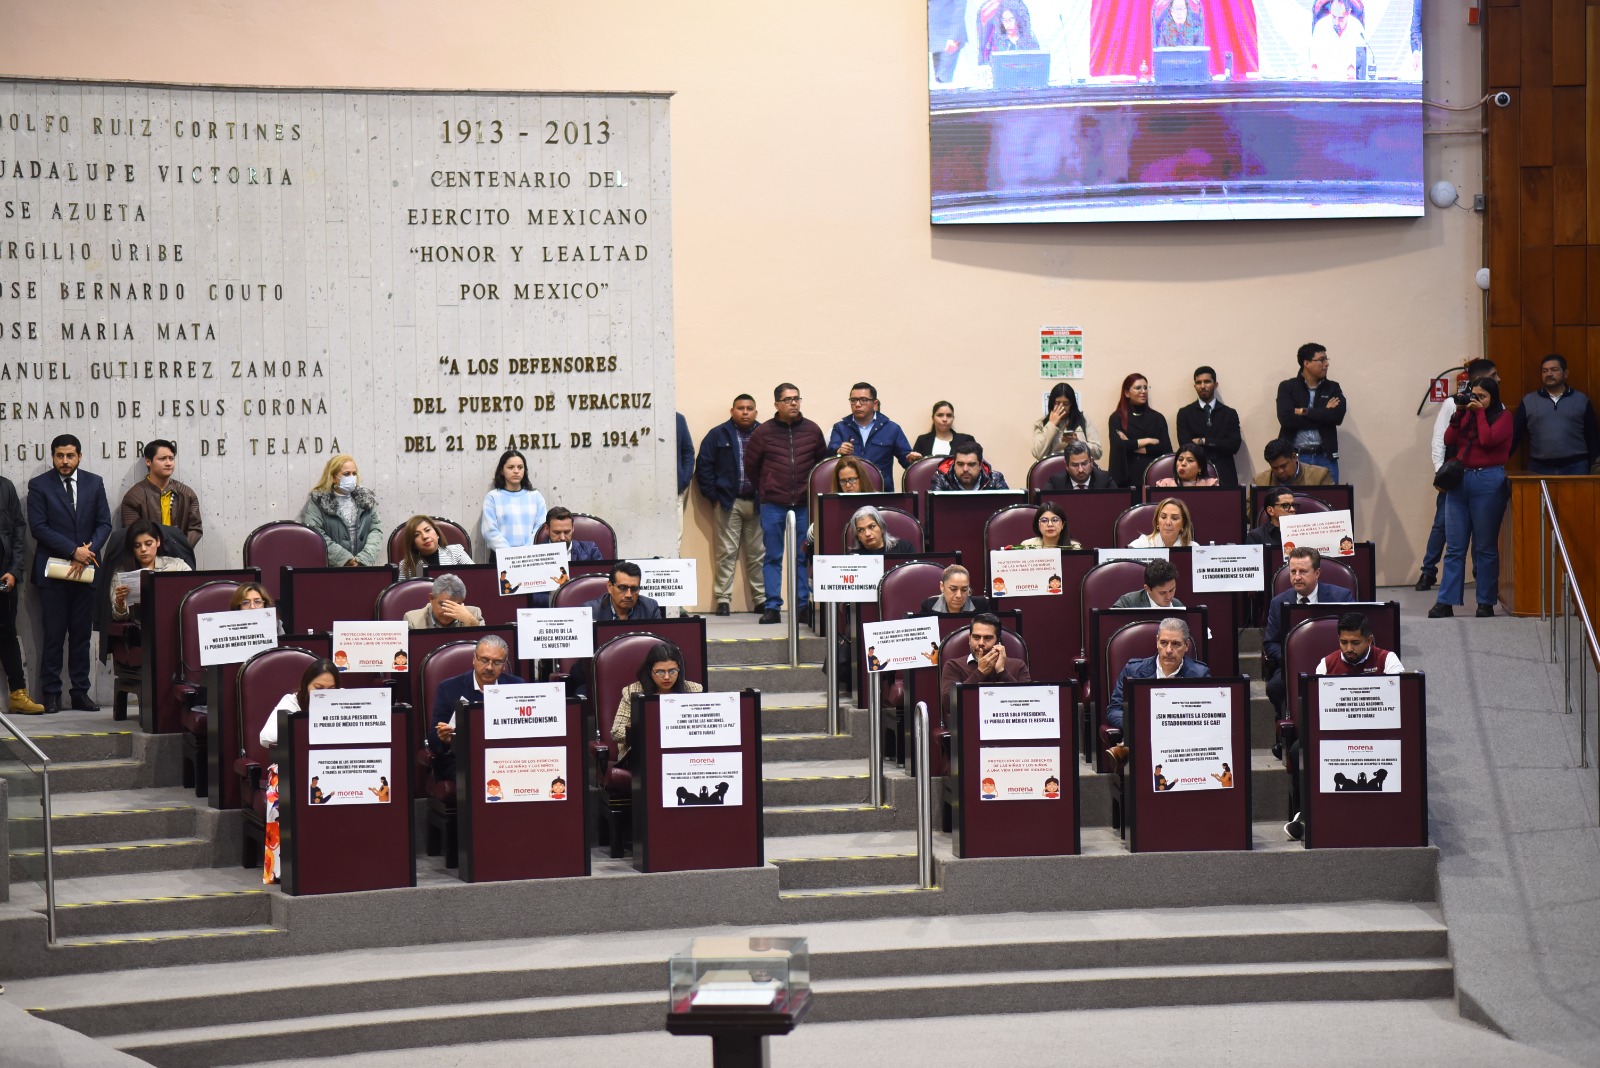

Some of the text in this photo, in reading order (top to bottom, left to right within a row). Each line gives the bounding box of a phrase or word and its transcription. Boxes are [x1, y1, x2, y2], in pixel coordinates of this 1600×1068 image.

[0, 113, 302, 141] OLFO RUIZ CORTINES
[442, 120, 504, 144] 1913
[545, 120, 611, 145] 2013
[159, 165, 292, 186] VICTORIA
[430, 170, 628, 188] CENTENARIO DEL
[51, 202, 147, 222] AZUETA
[407, 208, 648, 226] EJERCITO MEXICANO
[0, 242, 91, 261] RGILIO
[409, 244, 649, 263] “HONOR Y LEALTAD
[0, 282, 284, 302] SE BERNARDO COUTO
[460, 282, 610, 300] POR MEXICO”
[61, 322, 136, 340] MARIA
[157, 324, 217, 341] MATA
[91, 360, 214, 380] GUTIERREZ
[231, 360, 324, 379] ZAMORA
[438, 356, 618, 375] “A LOS DEFENSORES
[117, 401, 142, 418] DE
[158, 398, 226, 418] JESUS
[243, 397, 328, 418] CORONA
[413, 392, 652, 414] DEL PUERTO DE VERACRUZ
[4, 436, 341, 462] IGU LER DE TEJADA
[404, 427, 651, 452] DEL 21 DE ABRIL DE 1914”
